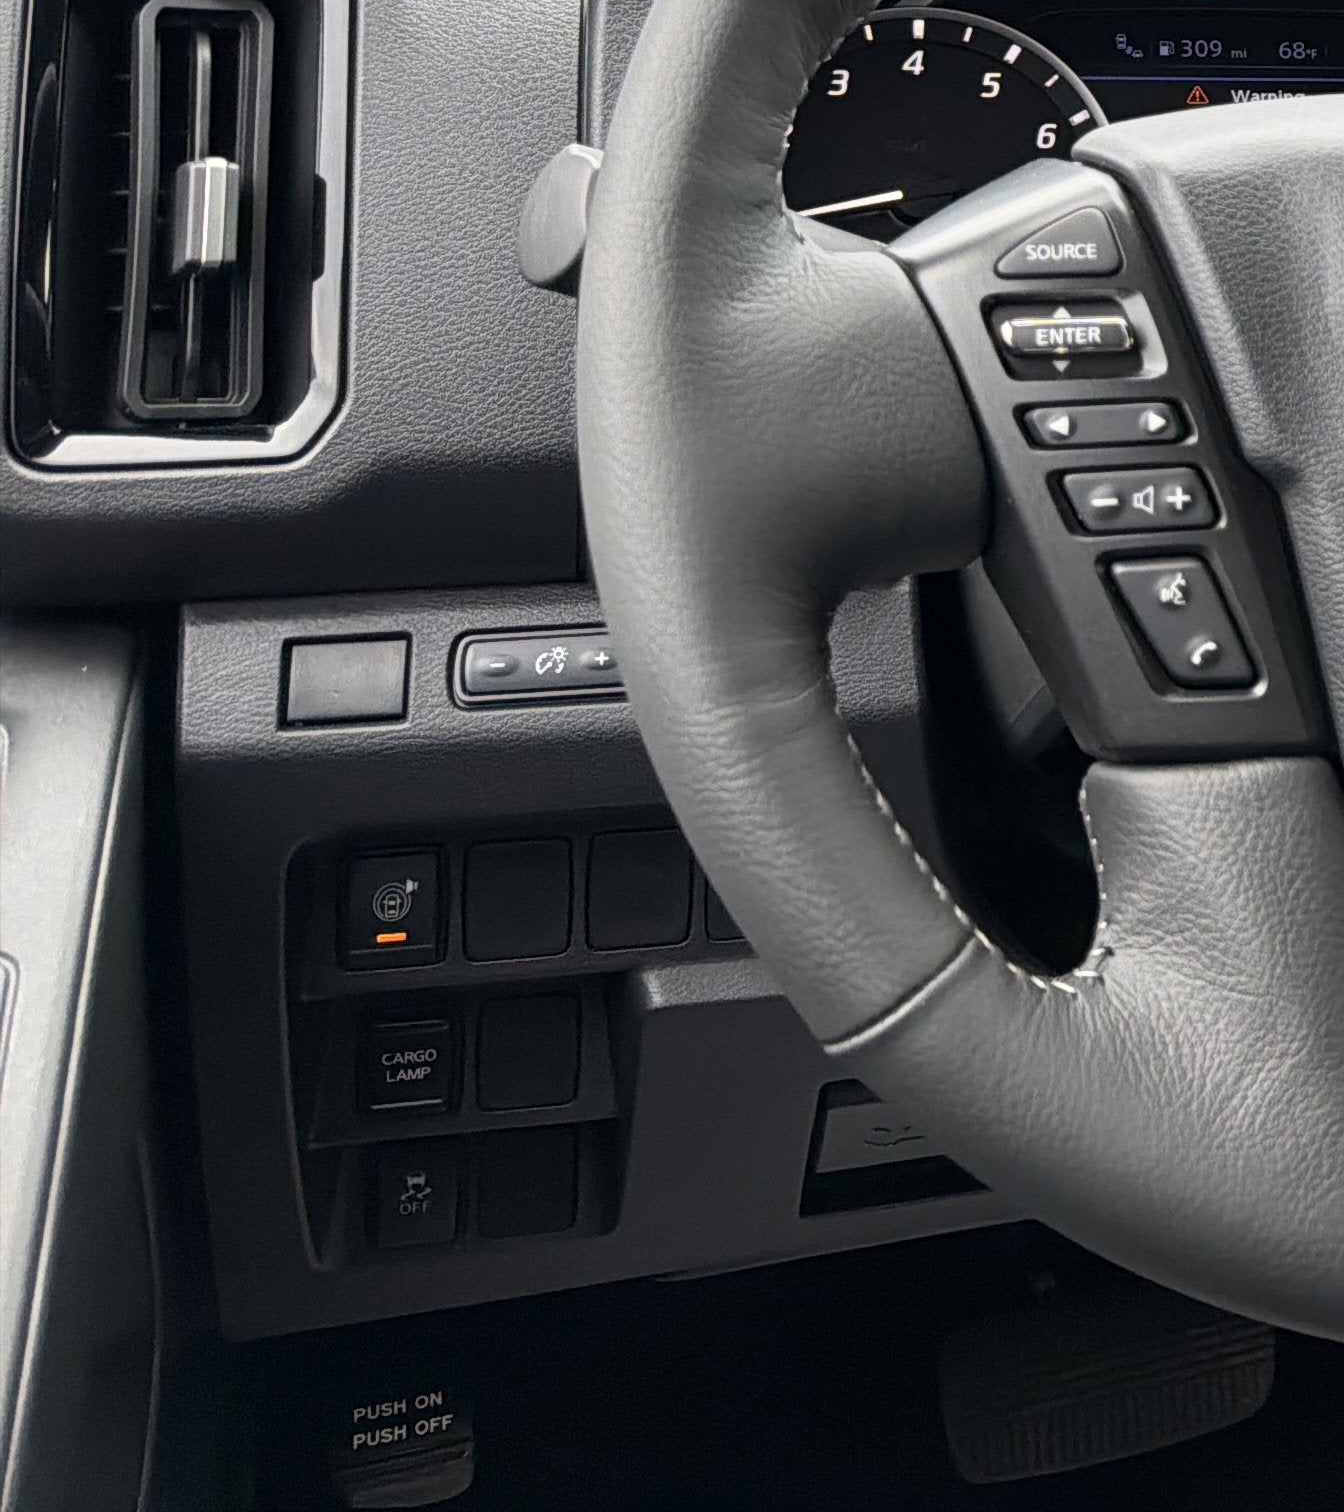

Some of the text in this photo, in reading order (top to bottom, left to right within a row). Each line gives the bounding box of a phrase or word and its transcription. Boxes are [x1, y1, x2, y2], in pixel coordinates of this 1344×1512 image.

[1180, 39, 1247, 59] 309 mi
[901, 50, 925, 76] 4
[827, 69, 850, 97] 3
[979, 72, 1002, 99] 5
[1036, 123, 1058, 149] 6
[1025, 242, 1098, 261] SOURCE
[1035, 326, 1101, 345] ENTER
[380, 1049, 437, 1066] CARGO
[386, 1065, 431, 1083] LAMP
[398, 1200, 430, 1216] OFF
[352, 1391, 444, 1424] PUSH ON
[352, 1414, 455, 1450] PUSH OFF
